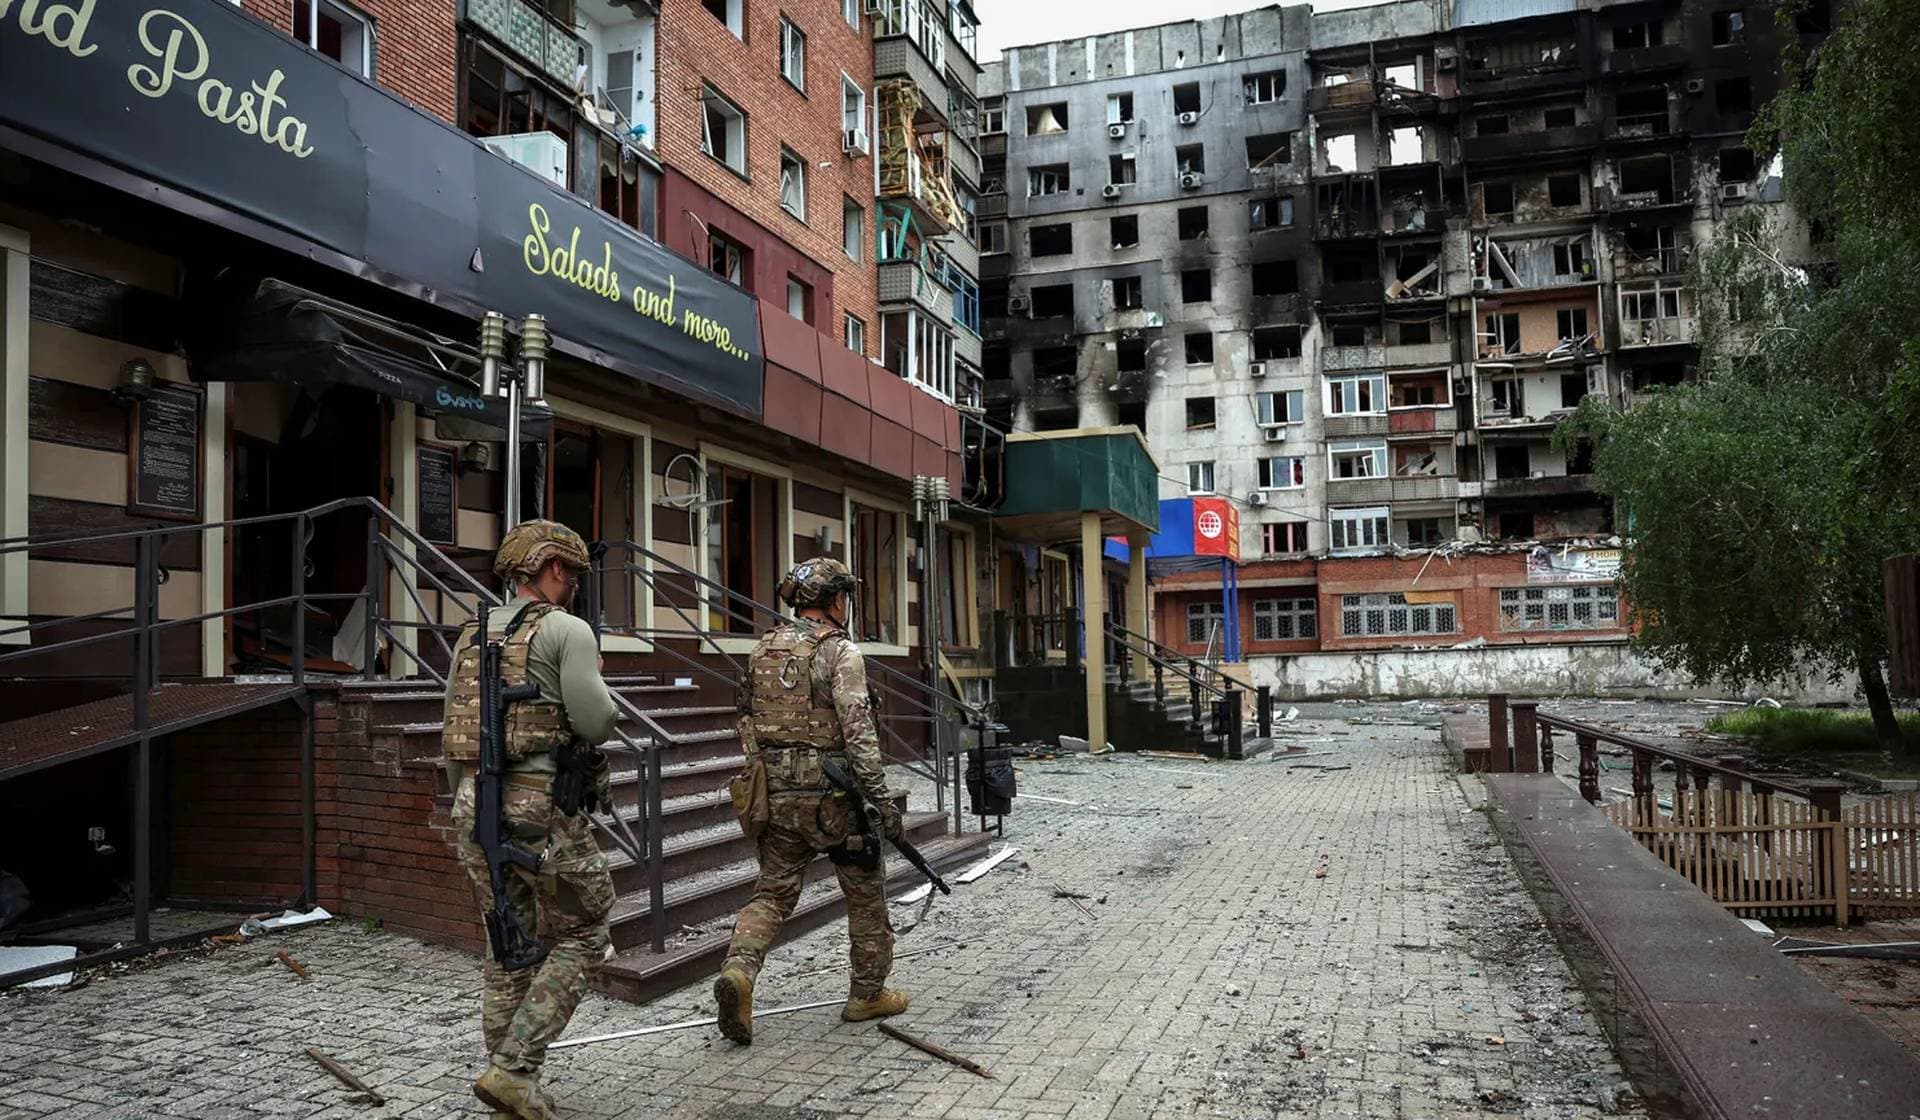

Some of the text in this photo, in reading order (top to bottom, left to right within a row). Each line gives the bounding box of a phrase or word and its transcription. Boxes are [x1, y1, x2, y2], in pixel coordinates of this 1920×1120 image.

[127, 9, 314, 159] Pasta
[523, 203, 751, 362] Salads and more...
[436, 385, 485, 411] Gusto
